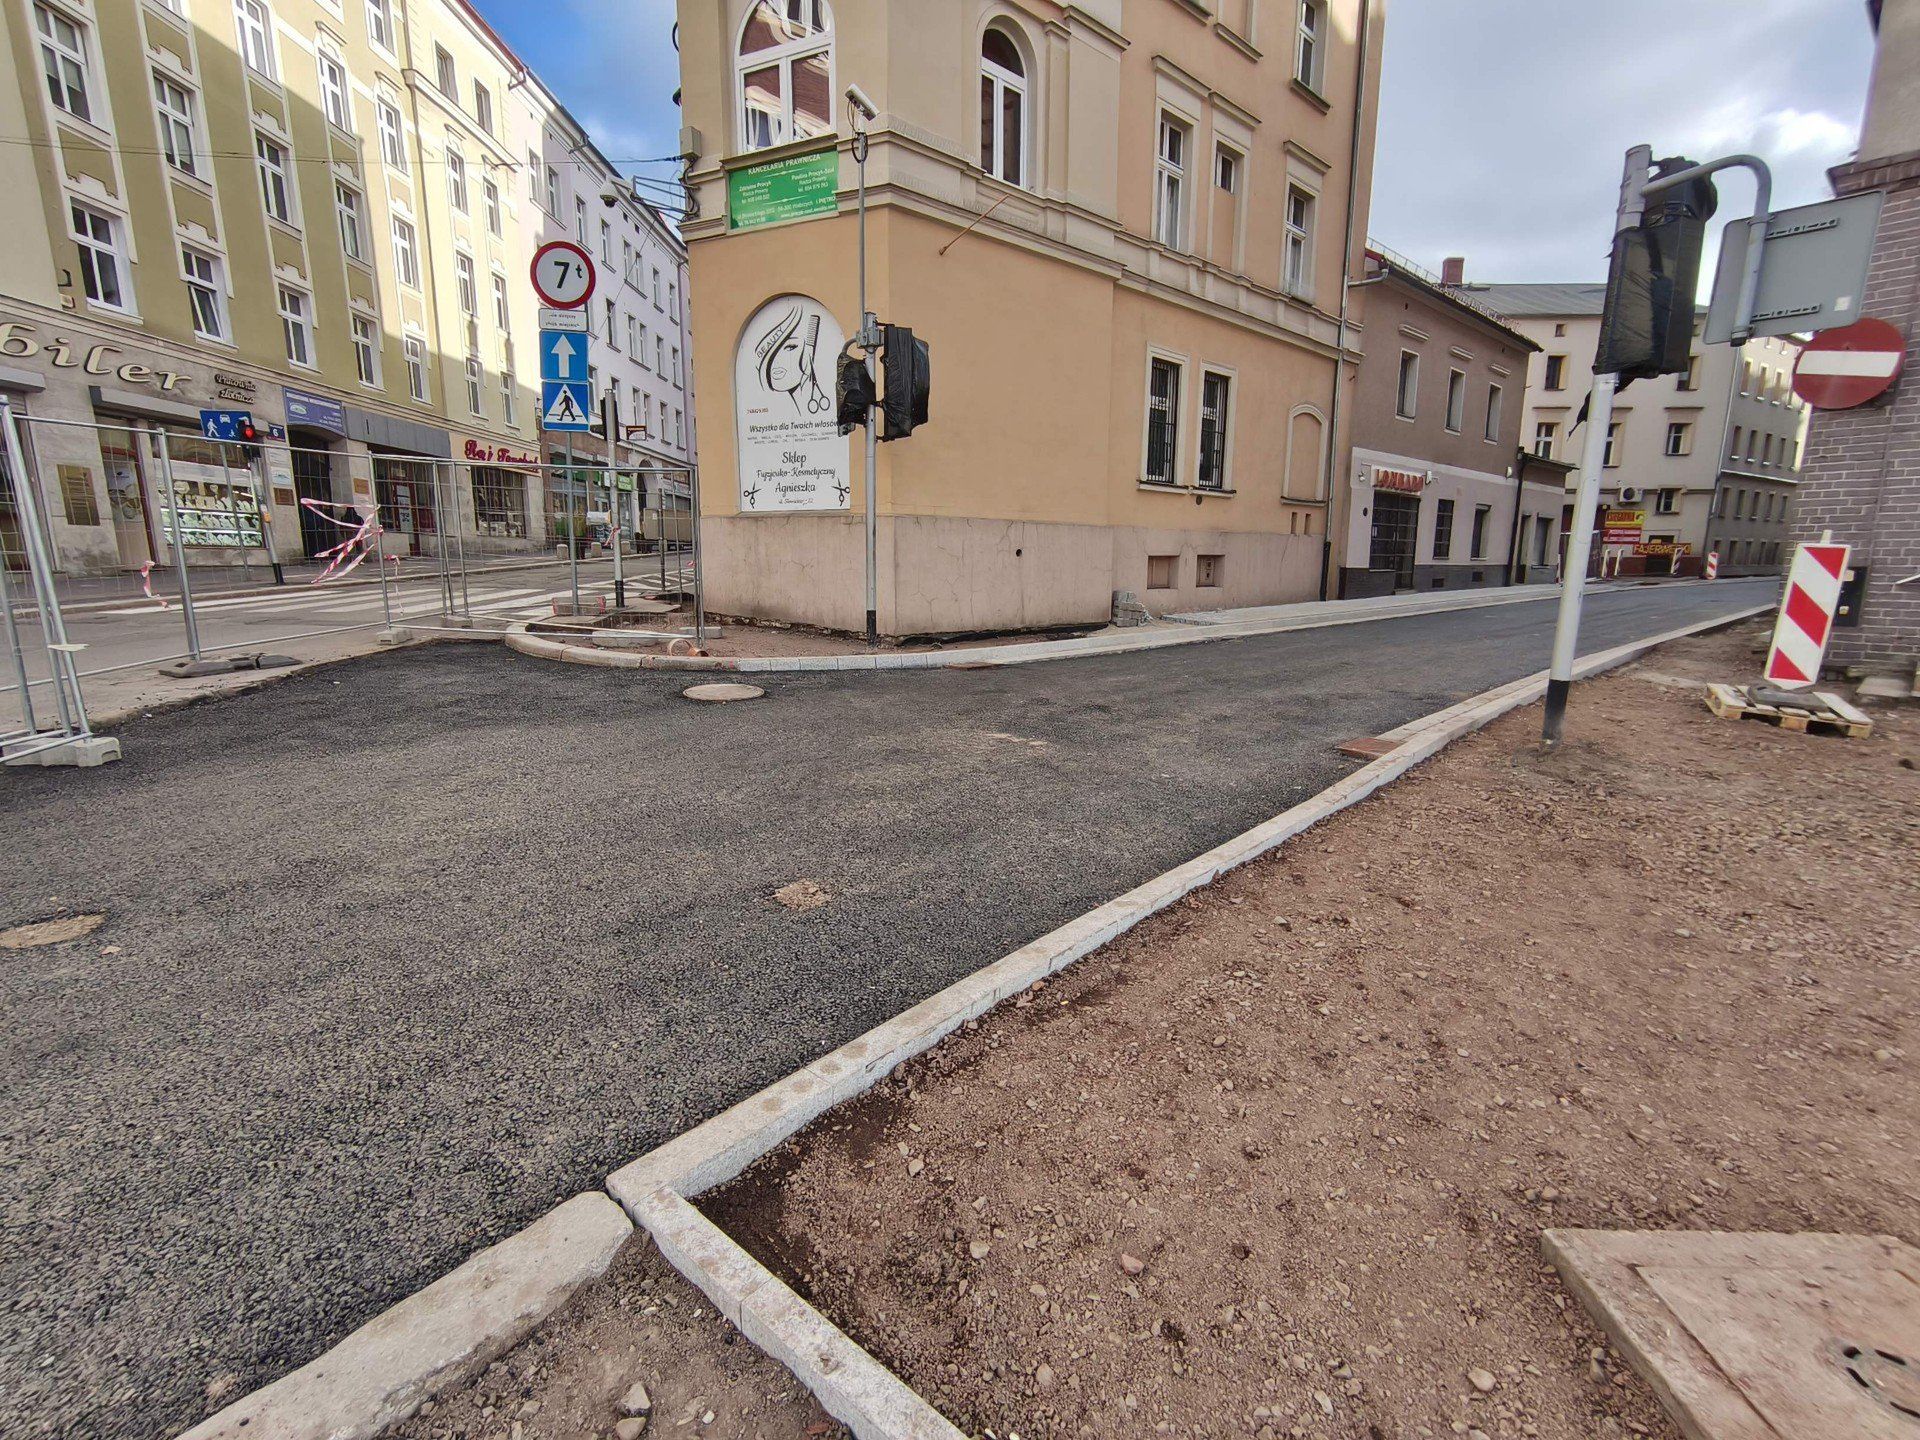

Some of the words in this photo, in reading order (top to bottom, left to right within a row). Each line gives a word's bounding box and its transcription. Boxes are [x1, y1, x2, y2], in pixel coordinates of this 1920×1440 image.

[748, 162, 784, 175] KANCELARIA
[786, 154, 821, 167] PRAWNICZA
[554, 260, 570, 289] 7
[576, 264, 582, 278] t
[756, 326, 784, 358] BEAUTY
[272, 428, 279, 436] 6
[750, 424, 778, 433] Wszystko
[790, 422, 814, 430] Twoich
[782, 451, 807, 468] Sklep
[774, 481, 816, 499] Agnieszka
